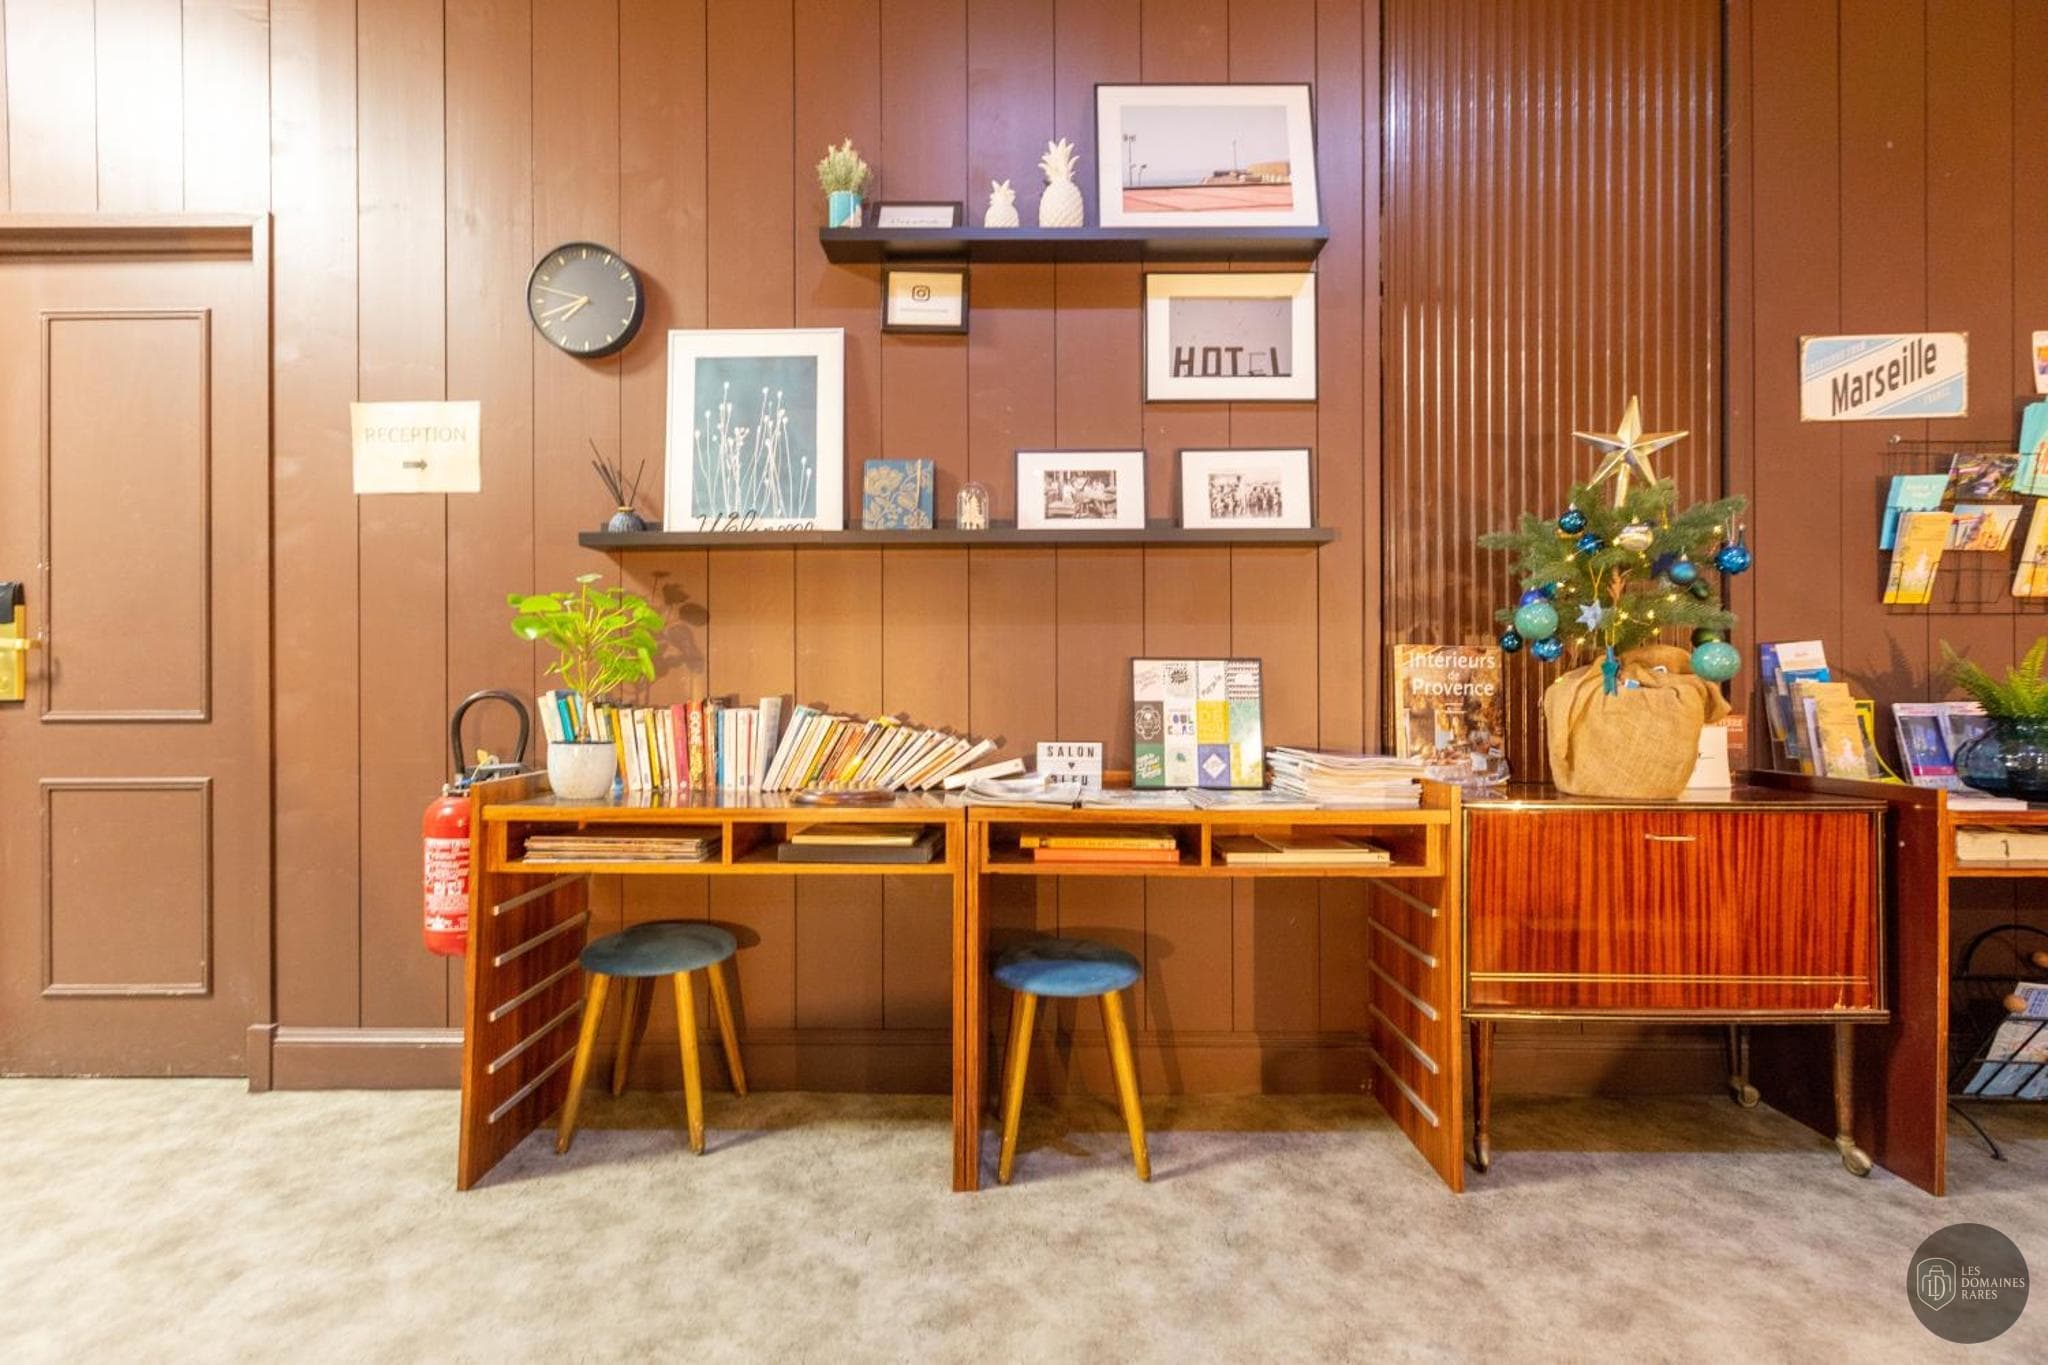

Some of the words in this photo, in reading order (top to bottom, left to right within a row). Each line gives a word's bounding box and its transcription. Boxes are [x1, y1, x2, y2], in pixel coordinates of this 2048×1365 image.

[1831, 337, 1937, 416] Marseille
[364, 425, 467, 443] RECEPTION
[1409, 650, 1496, 669] Intérieurs
[1447, 670, 1460, 681] de
[1412, 677, 1495, 697] Provence
[1046, 745, 1095, 758] SALON
